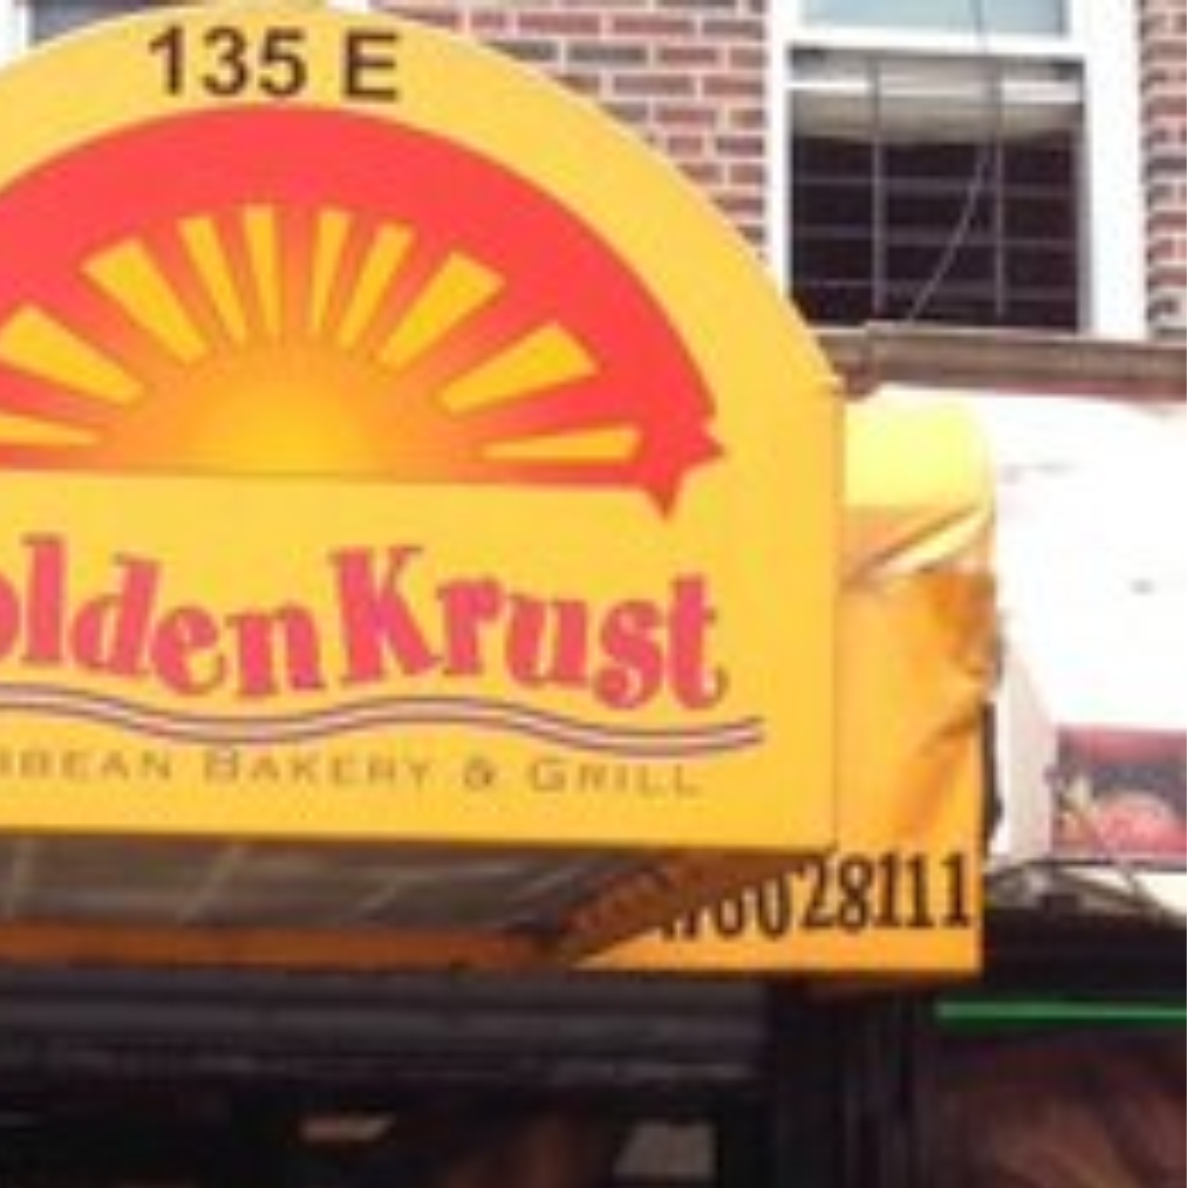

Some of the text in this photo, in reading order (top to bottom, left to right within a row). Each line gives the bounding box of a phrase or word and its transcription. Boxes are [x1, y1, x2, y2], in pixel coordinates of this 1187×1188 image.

[148, 24, 400, 101] 135 E
[461, 759, 500, 792] &
